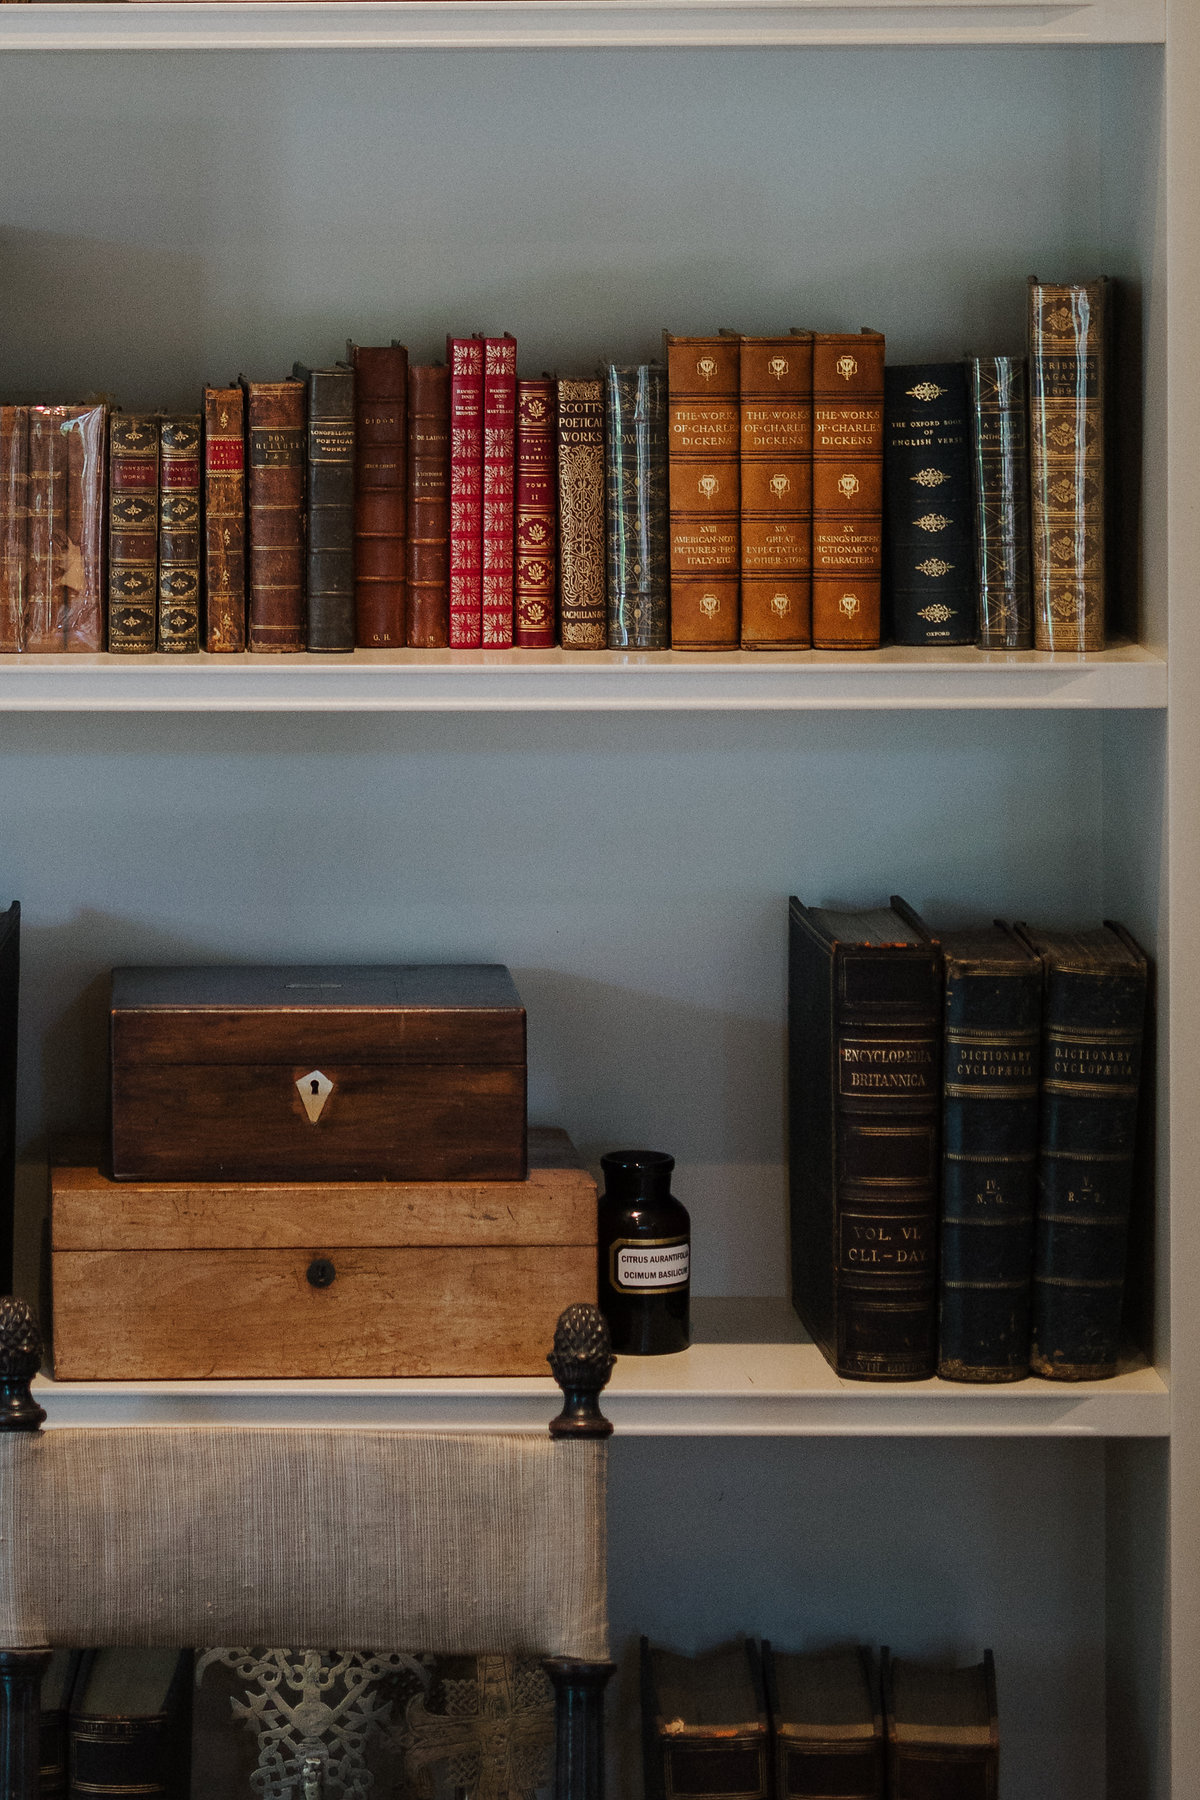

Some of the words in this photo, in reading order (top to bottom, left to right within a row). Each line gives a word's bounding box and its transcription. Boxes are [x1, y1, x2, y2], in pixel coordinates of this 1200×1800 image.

[559, 403, 604, 414] SCOTT'S
[910, 420, 940, 428] OXFORD
[943, 419, 962, 427] BOOK
[561, 431, 603, 442] WORKS
[753, 436, 803, 445] DICKENS
[821, 436, 873, 445] DICKENS
[682, 437, 732, 446] DICKENS
[892, 439, 932, 447] ENGLISH
[937, 437, 963, 445] VERSE
[775, 525, 787, 533] XIV
[843, 525, 854, 533] XX
[766, 535, 795, 543] GREAT
[821, 556, 874, 564] CHARACTERS
[960, 1050, 1032, 1062] DICTIONARY
[851, 1072, 927, 1087] BRITANNICA
[621, 1255, 649, 1264] CITRUS
[624, 1271, 657, 1280] OCIMUM
